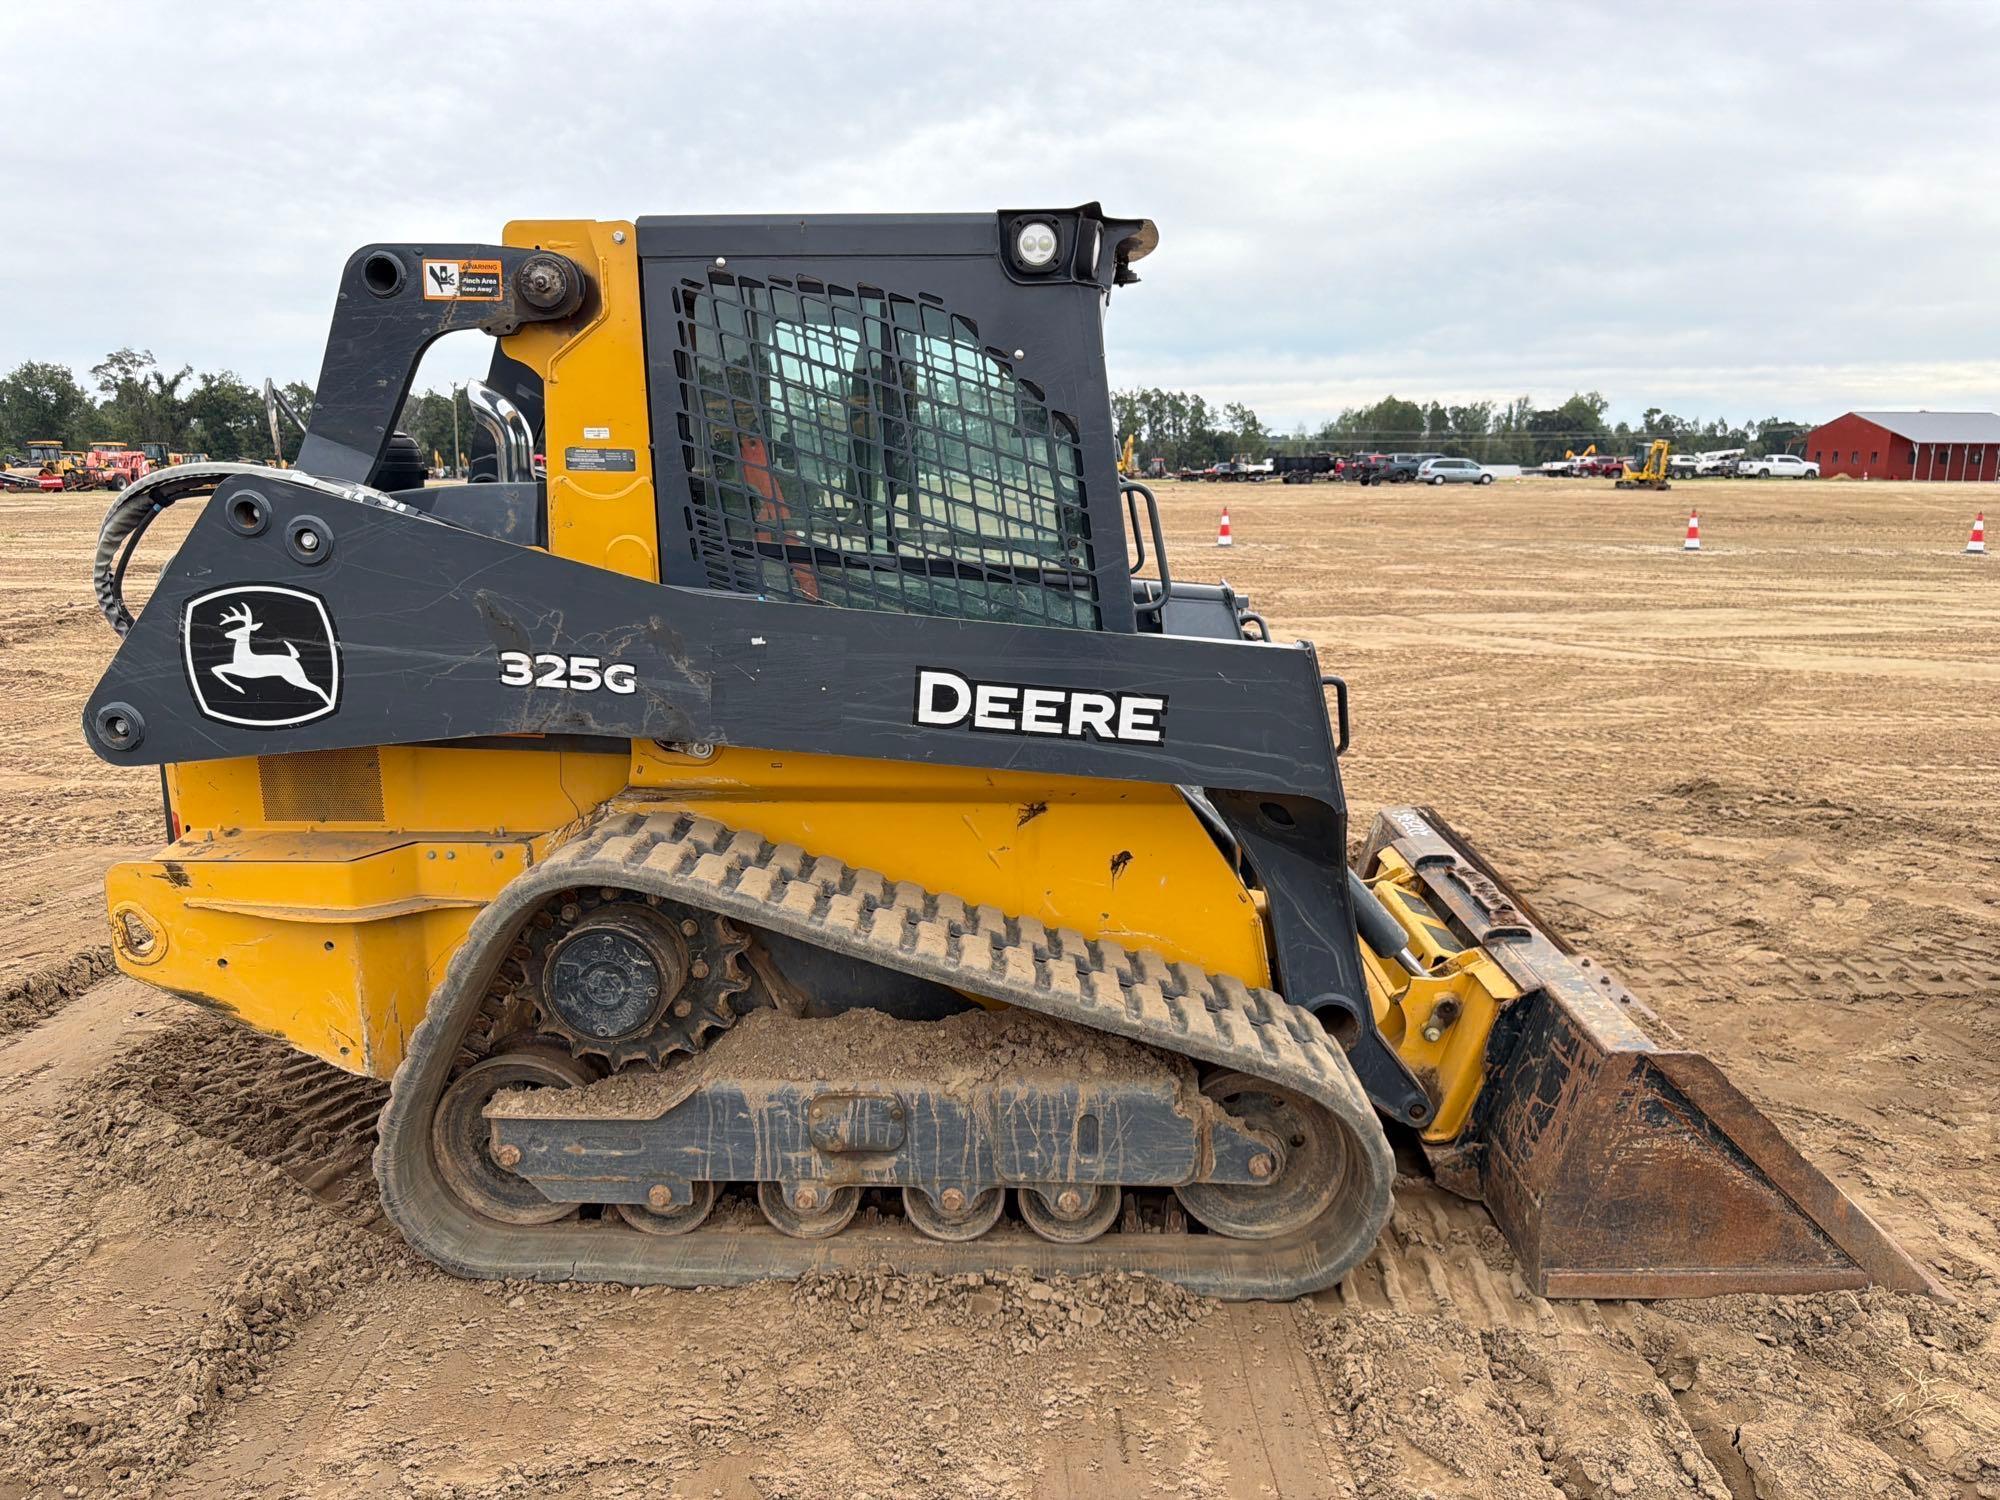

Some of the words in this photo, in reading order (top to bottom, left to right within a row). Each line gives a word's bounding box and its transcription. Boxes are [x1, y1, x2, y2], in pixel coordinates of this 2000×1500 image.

[477, 286, 493, 294] Away
[482, 277, 497, 285] Area
[500, 651, 636, 694] 325G
[917, 670, 1164, 742] DEERE
